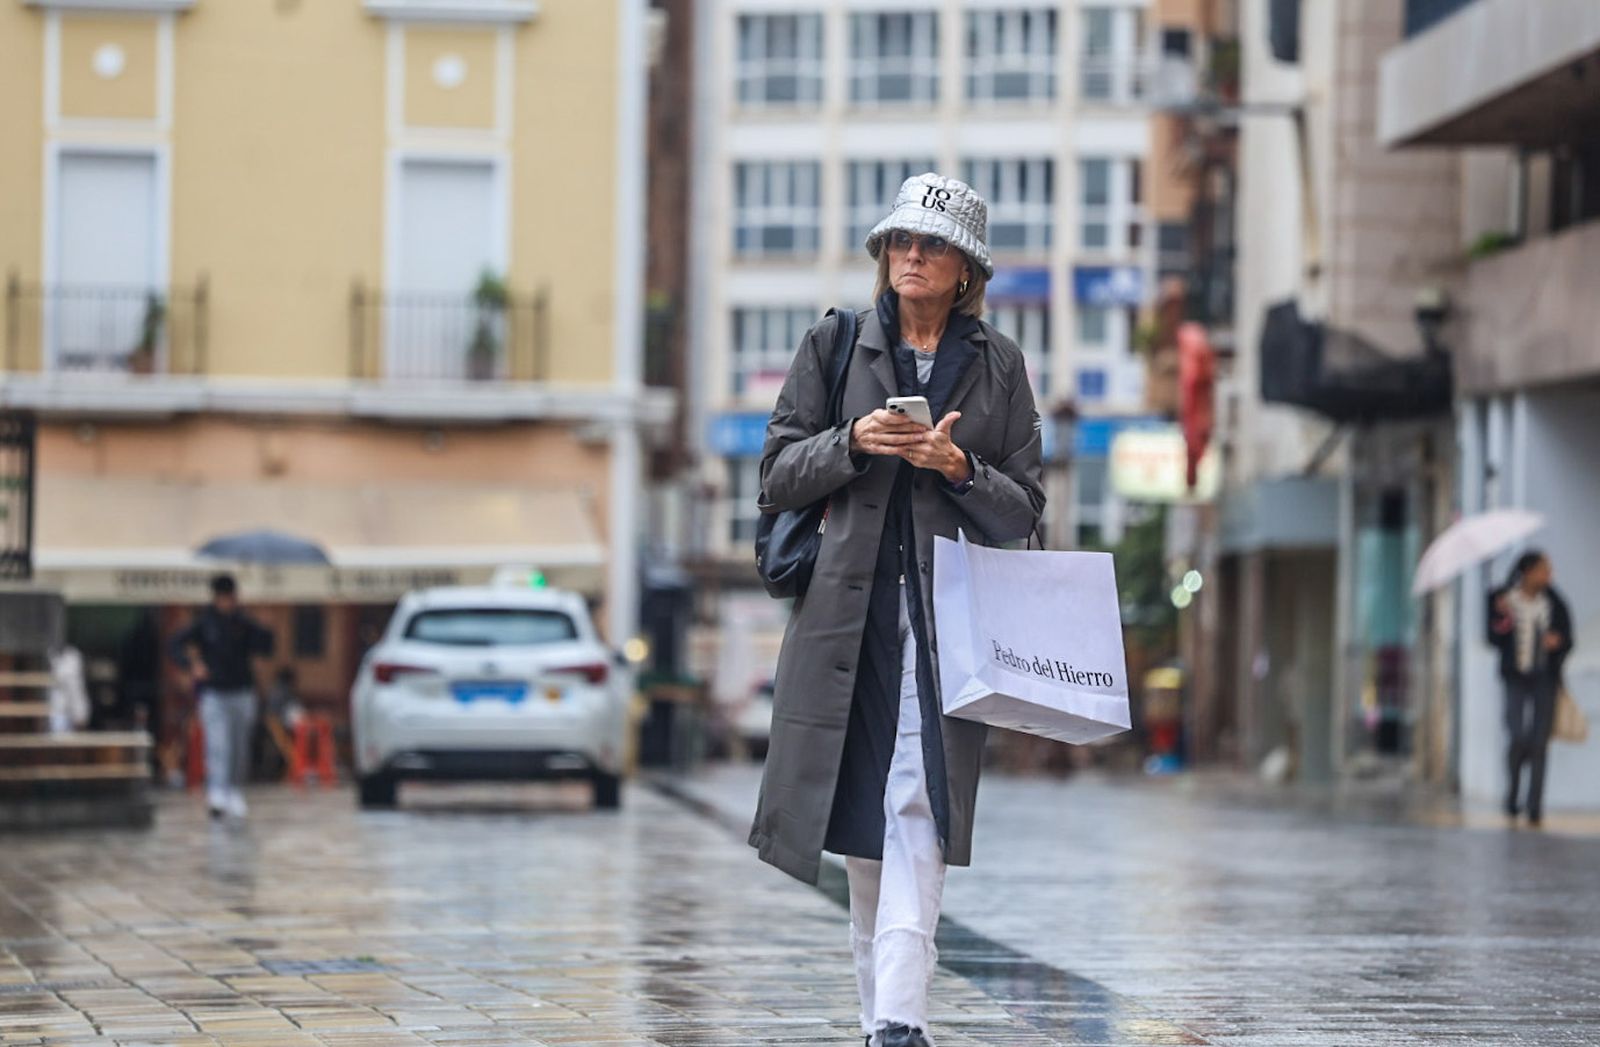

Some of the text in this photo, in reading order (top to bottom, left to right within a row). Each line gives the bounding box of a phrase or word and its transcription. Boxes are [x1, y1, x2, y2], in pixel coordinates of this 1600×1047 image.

[926, 185, 951, 201] TO
[921, 195, 946, 212] US
[992, 639, 1113, 687] Pedro del Hierro
